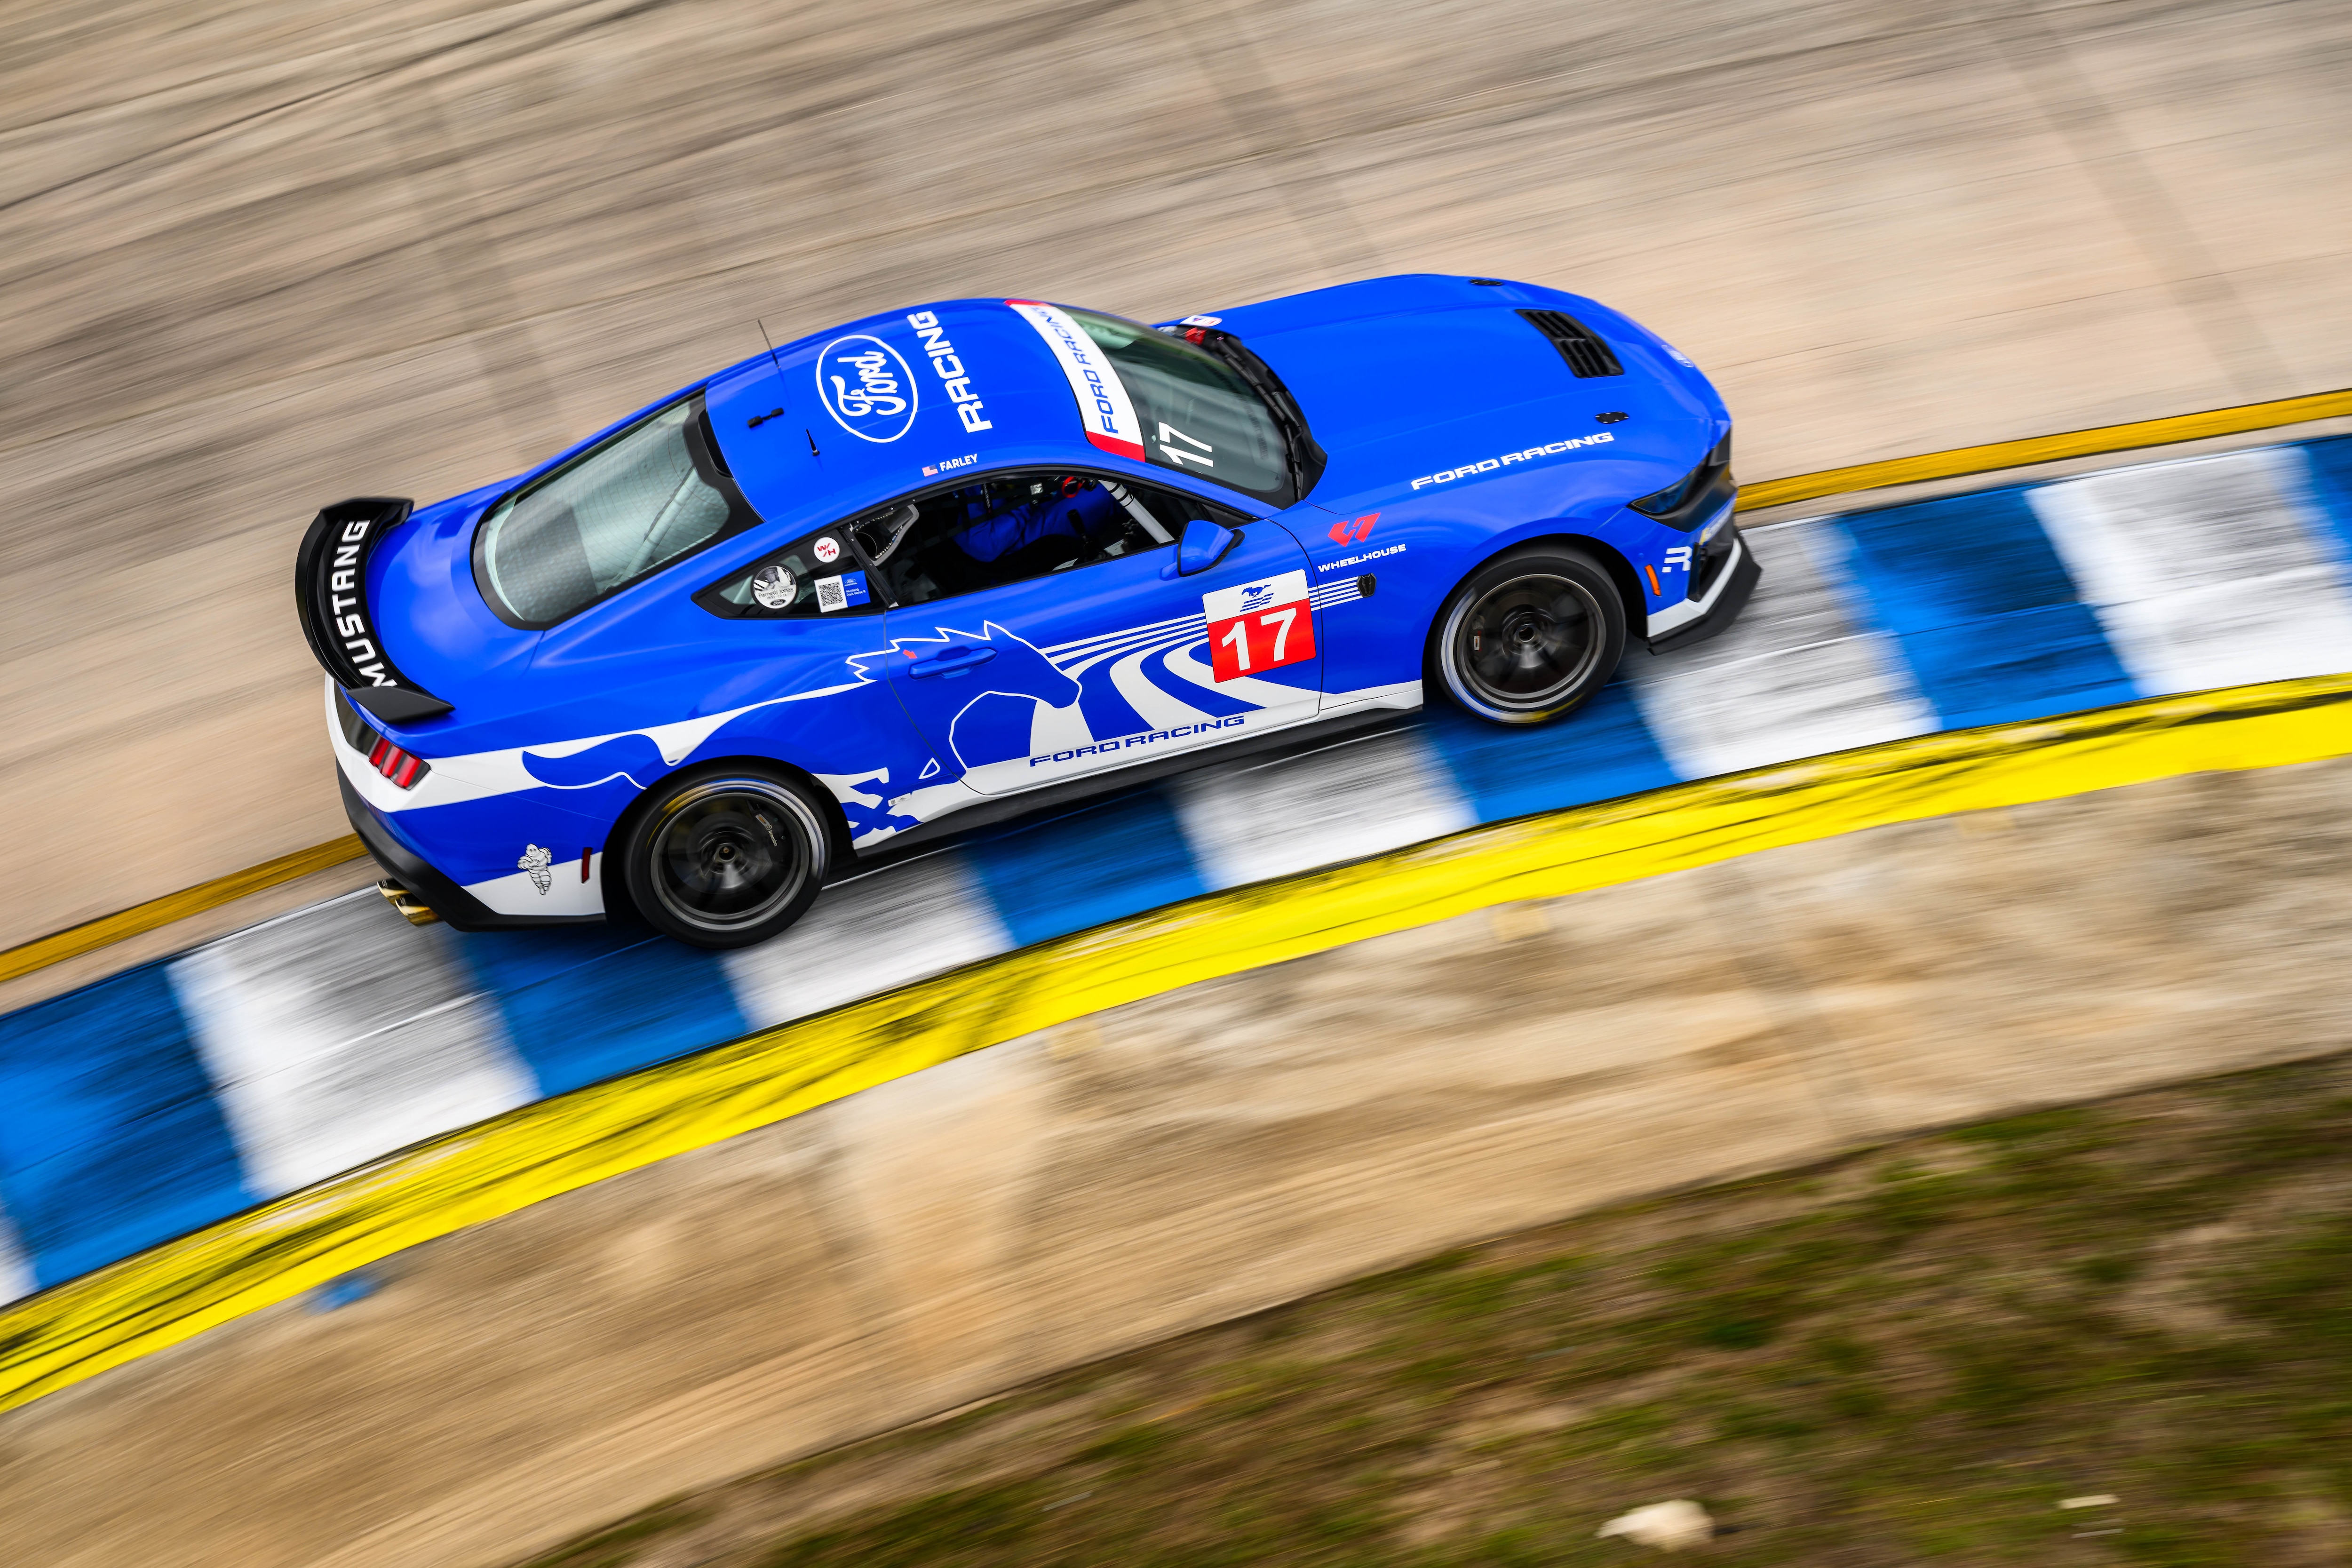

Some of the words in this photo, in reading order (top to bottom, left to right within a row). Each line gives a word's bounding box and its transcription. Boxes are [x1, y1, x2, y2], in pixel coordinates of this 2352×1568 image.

[830, 351, 906, 417] Ford
[906, 310, 993, 433] RACING
[1083, 369, 1119, 434] FORD
[939, 453, 978, 472] FARLEY
[1158, 422, 1214, 468] 17
[1411, 459, 1500, 490] FORD
[1502, 432, 1615, 466] RACING
[1318, 543, 1406, 573] WHEELHOUSE
[331, 520, 397, 687] MUSTANG
[1222, 607, 1297, 671] 17
[1029, 741, 1120, 767] FORD
[1125, 715, 1244, 748] RACING
